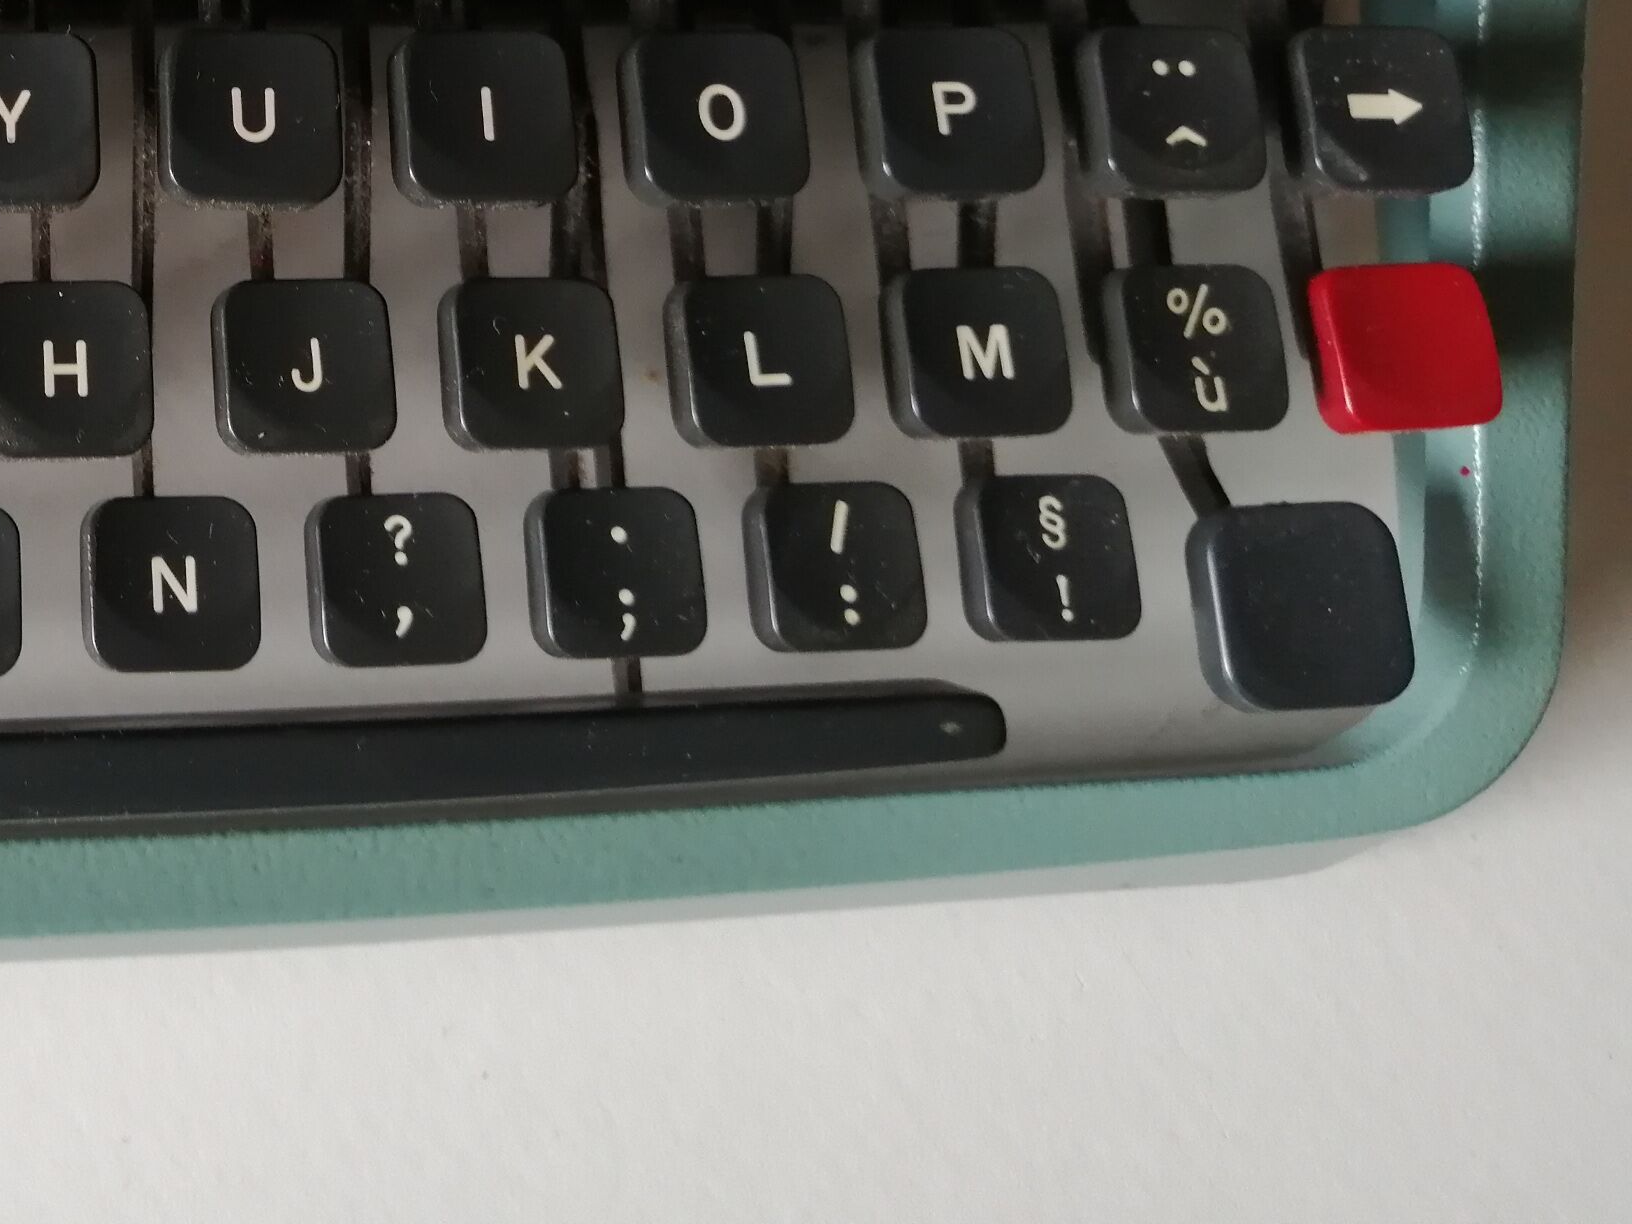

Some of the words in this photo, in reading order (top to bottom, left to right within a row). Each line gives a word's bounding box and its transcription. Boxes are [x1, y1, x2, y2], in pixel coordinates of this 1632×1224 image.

[231, 86, 276, 143] U
[480, 86, 495, 142] I
[698, 83, 746, 141] O
[931, 81, 977, 136] P
[1166, 283, 1229, 339] %
[42, 339, 89, 398] H
[291, 337, 323, 393] J
[514, 334, 563, 390] K
[743, 330, 793, 387] L
[956, 323, 1015, 380] M
[1191, 356, 1229, 413] ù
[383, 514, 413, 566] ?
[1038, 495, 1067, 550] §
[151, 555, 198, 614] N
